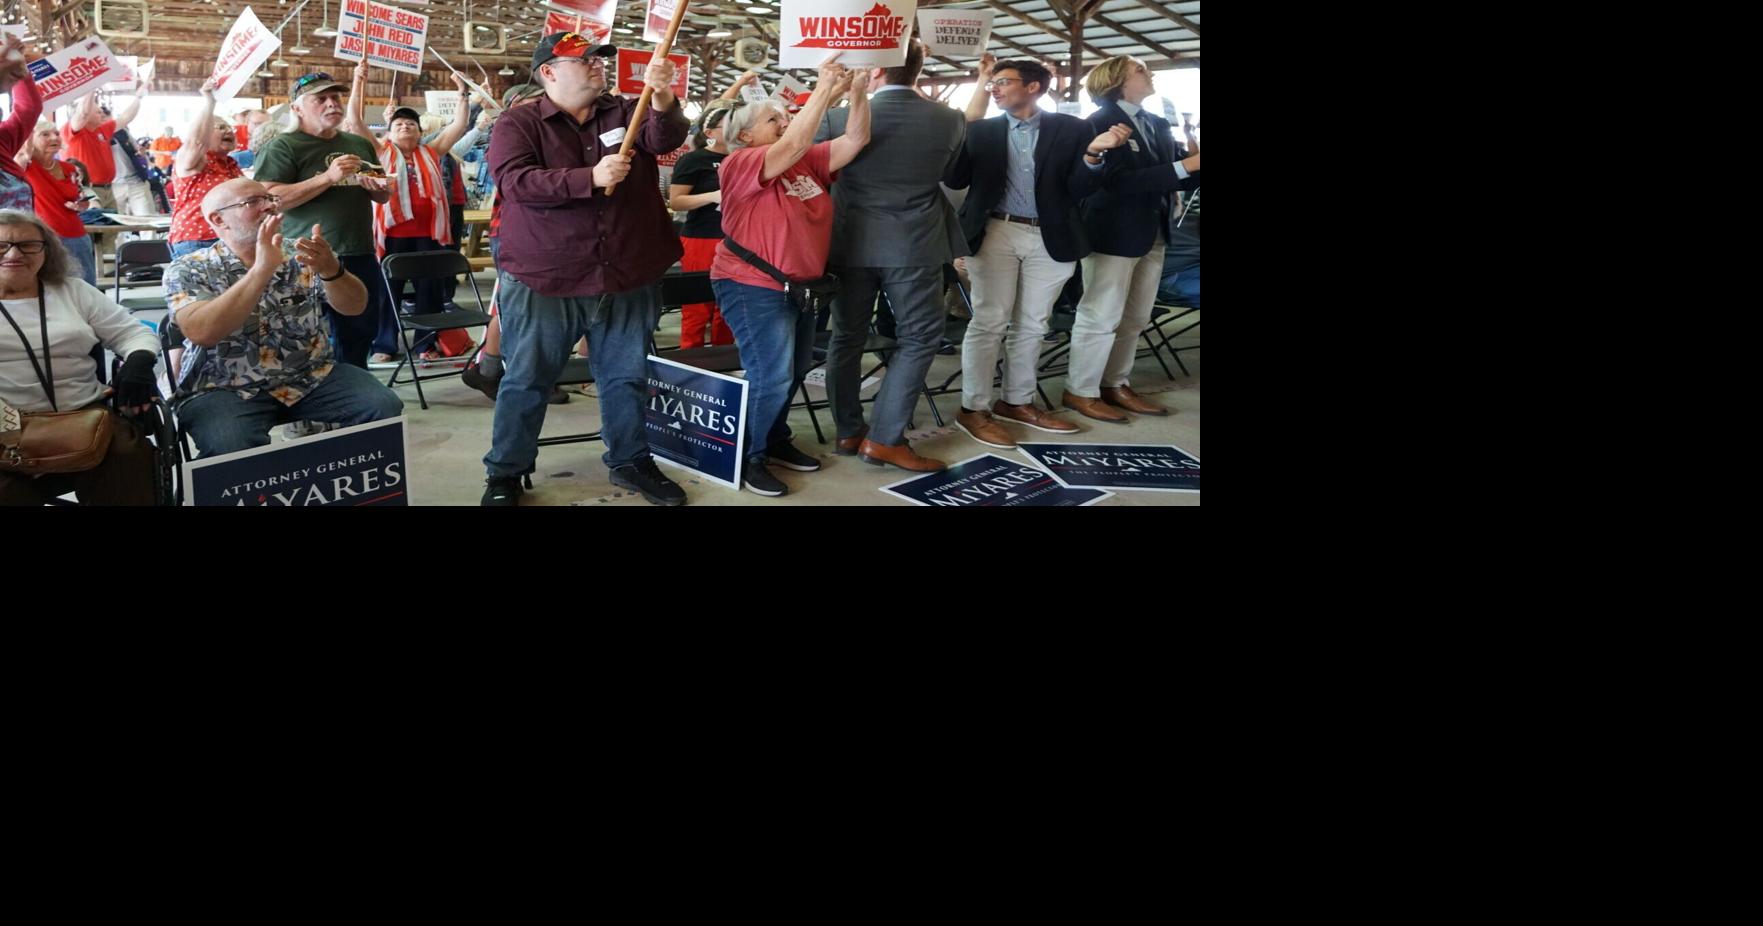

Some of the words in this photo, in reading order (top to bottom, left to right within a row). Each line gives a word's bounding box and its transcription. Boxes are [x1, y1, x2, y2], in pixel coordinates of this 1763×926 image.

[395, 12, 424, 30] SEARS
[798, 17, 904, 37] WINSOME
[388, 28, 413, 45] REID
[936, 35, 979, 45] DELIVER
[377, 44, 419, 64] MIYARES
[683, 388, 727, 407] GENERAL
[221, 469, 311, 498] ATTORNEY
[316, 451, 384, 473] GENERAL
